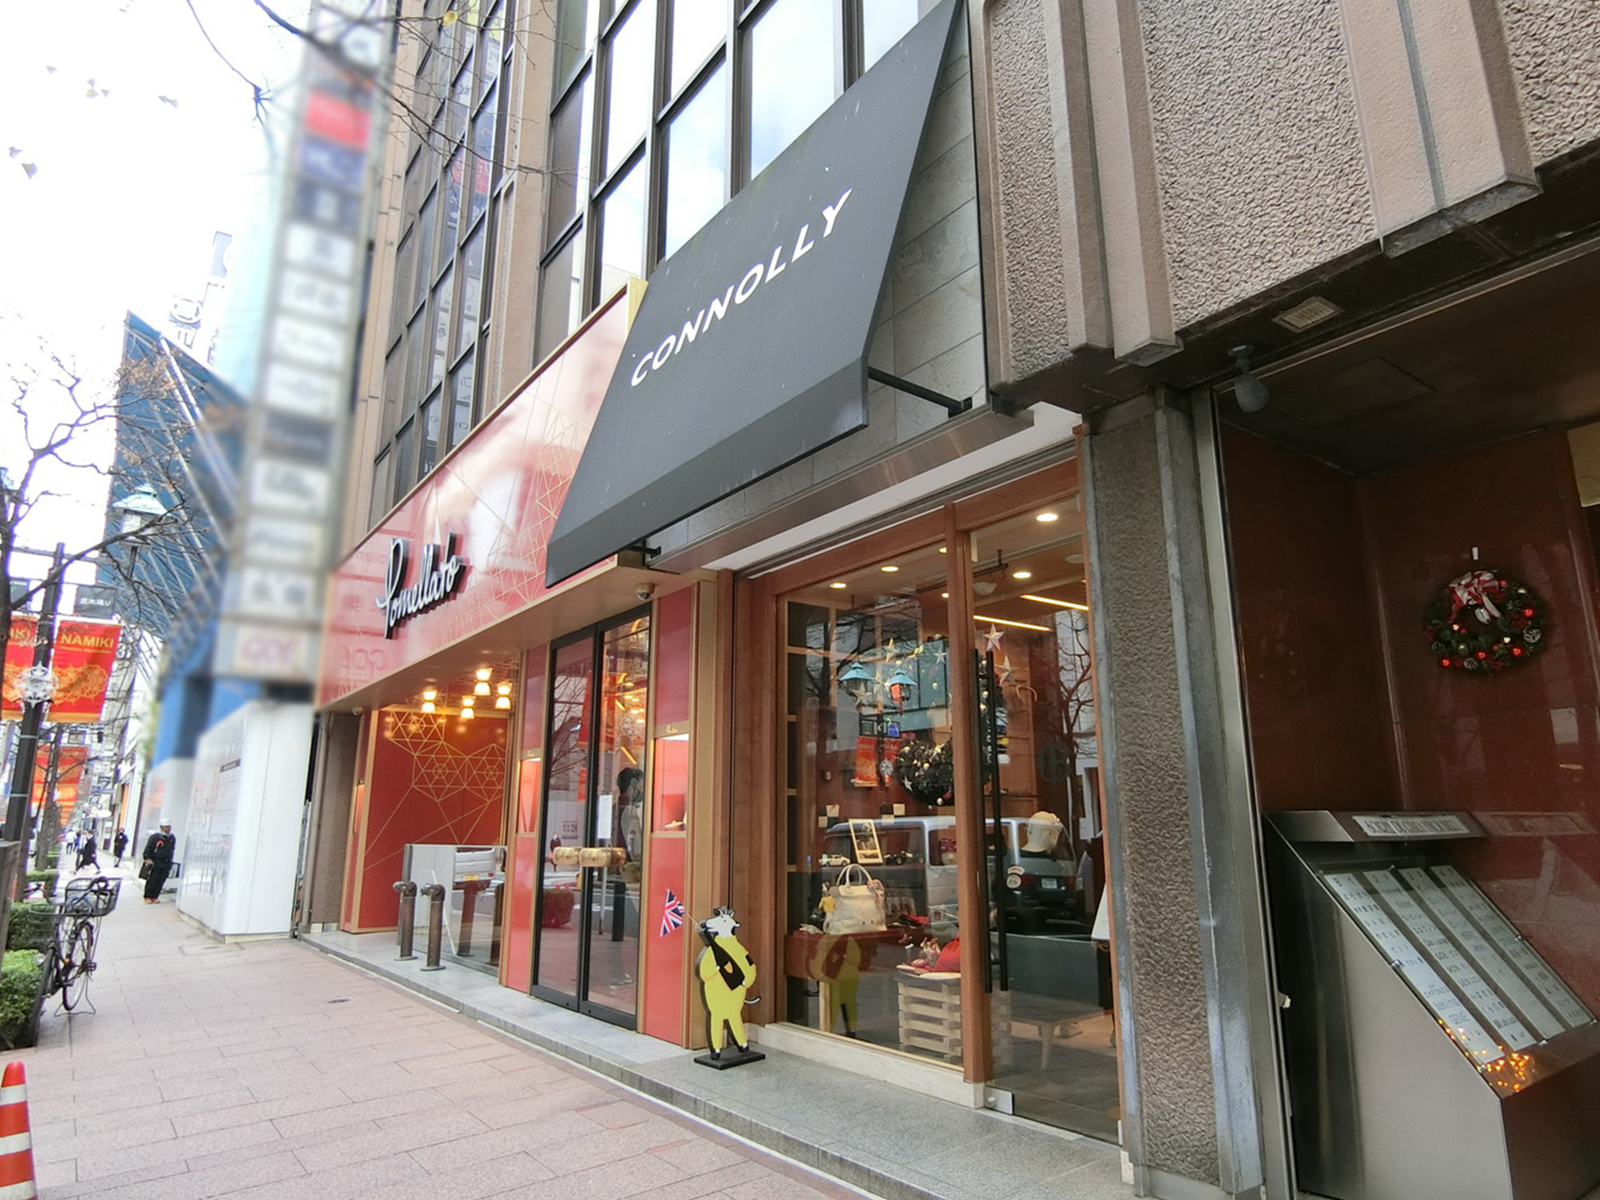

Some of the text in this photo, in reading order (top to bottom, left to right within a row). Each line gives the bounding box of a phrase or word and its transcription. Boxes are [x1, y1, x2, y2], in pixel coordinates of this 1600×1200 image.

[631, 188, 852, 386] CONNOLLY
[375, 533, 466, 639] Pomellato
[61, 634, 114, 649] NAMIKI
